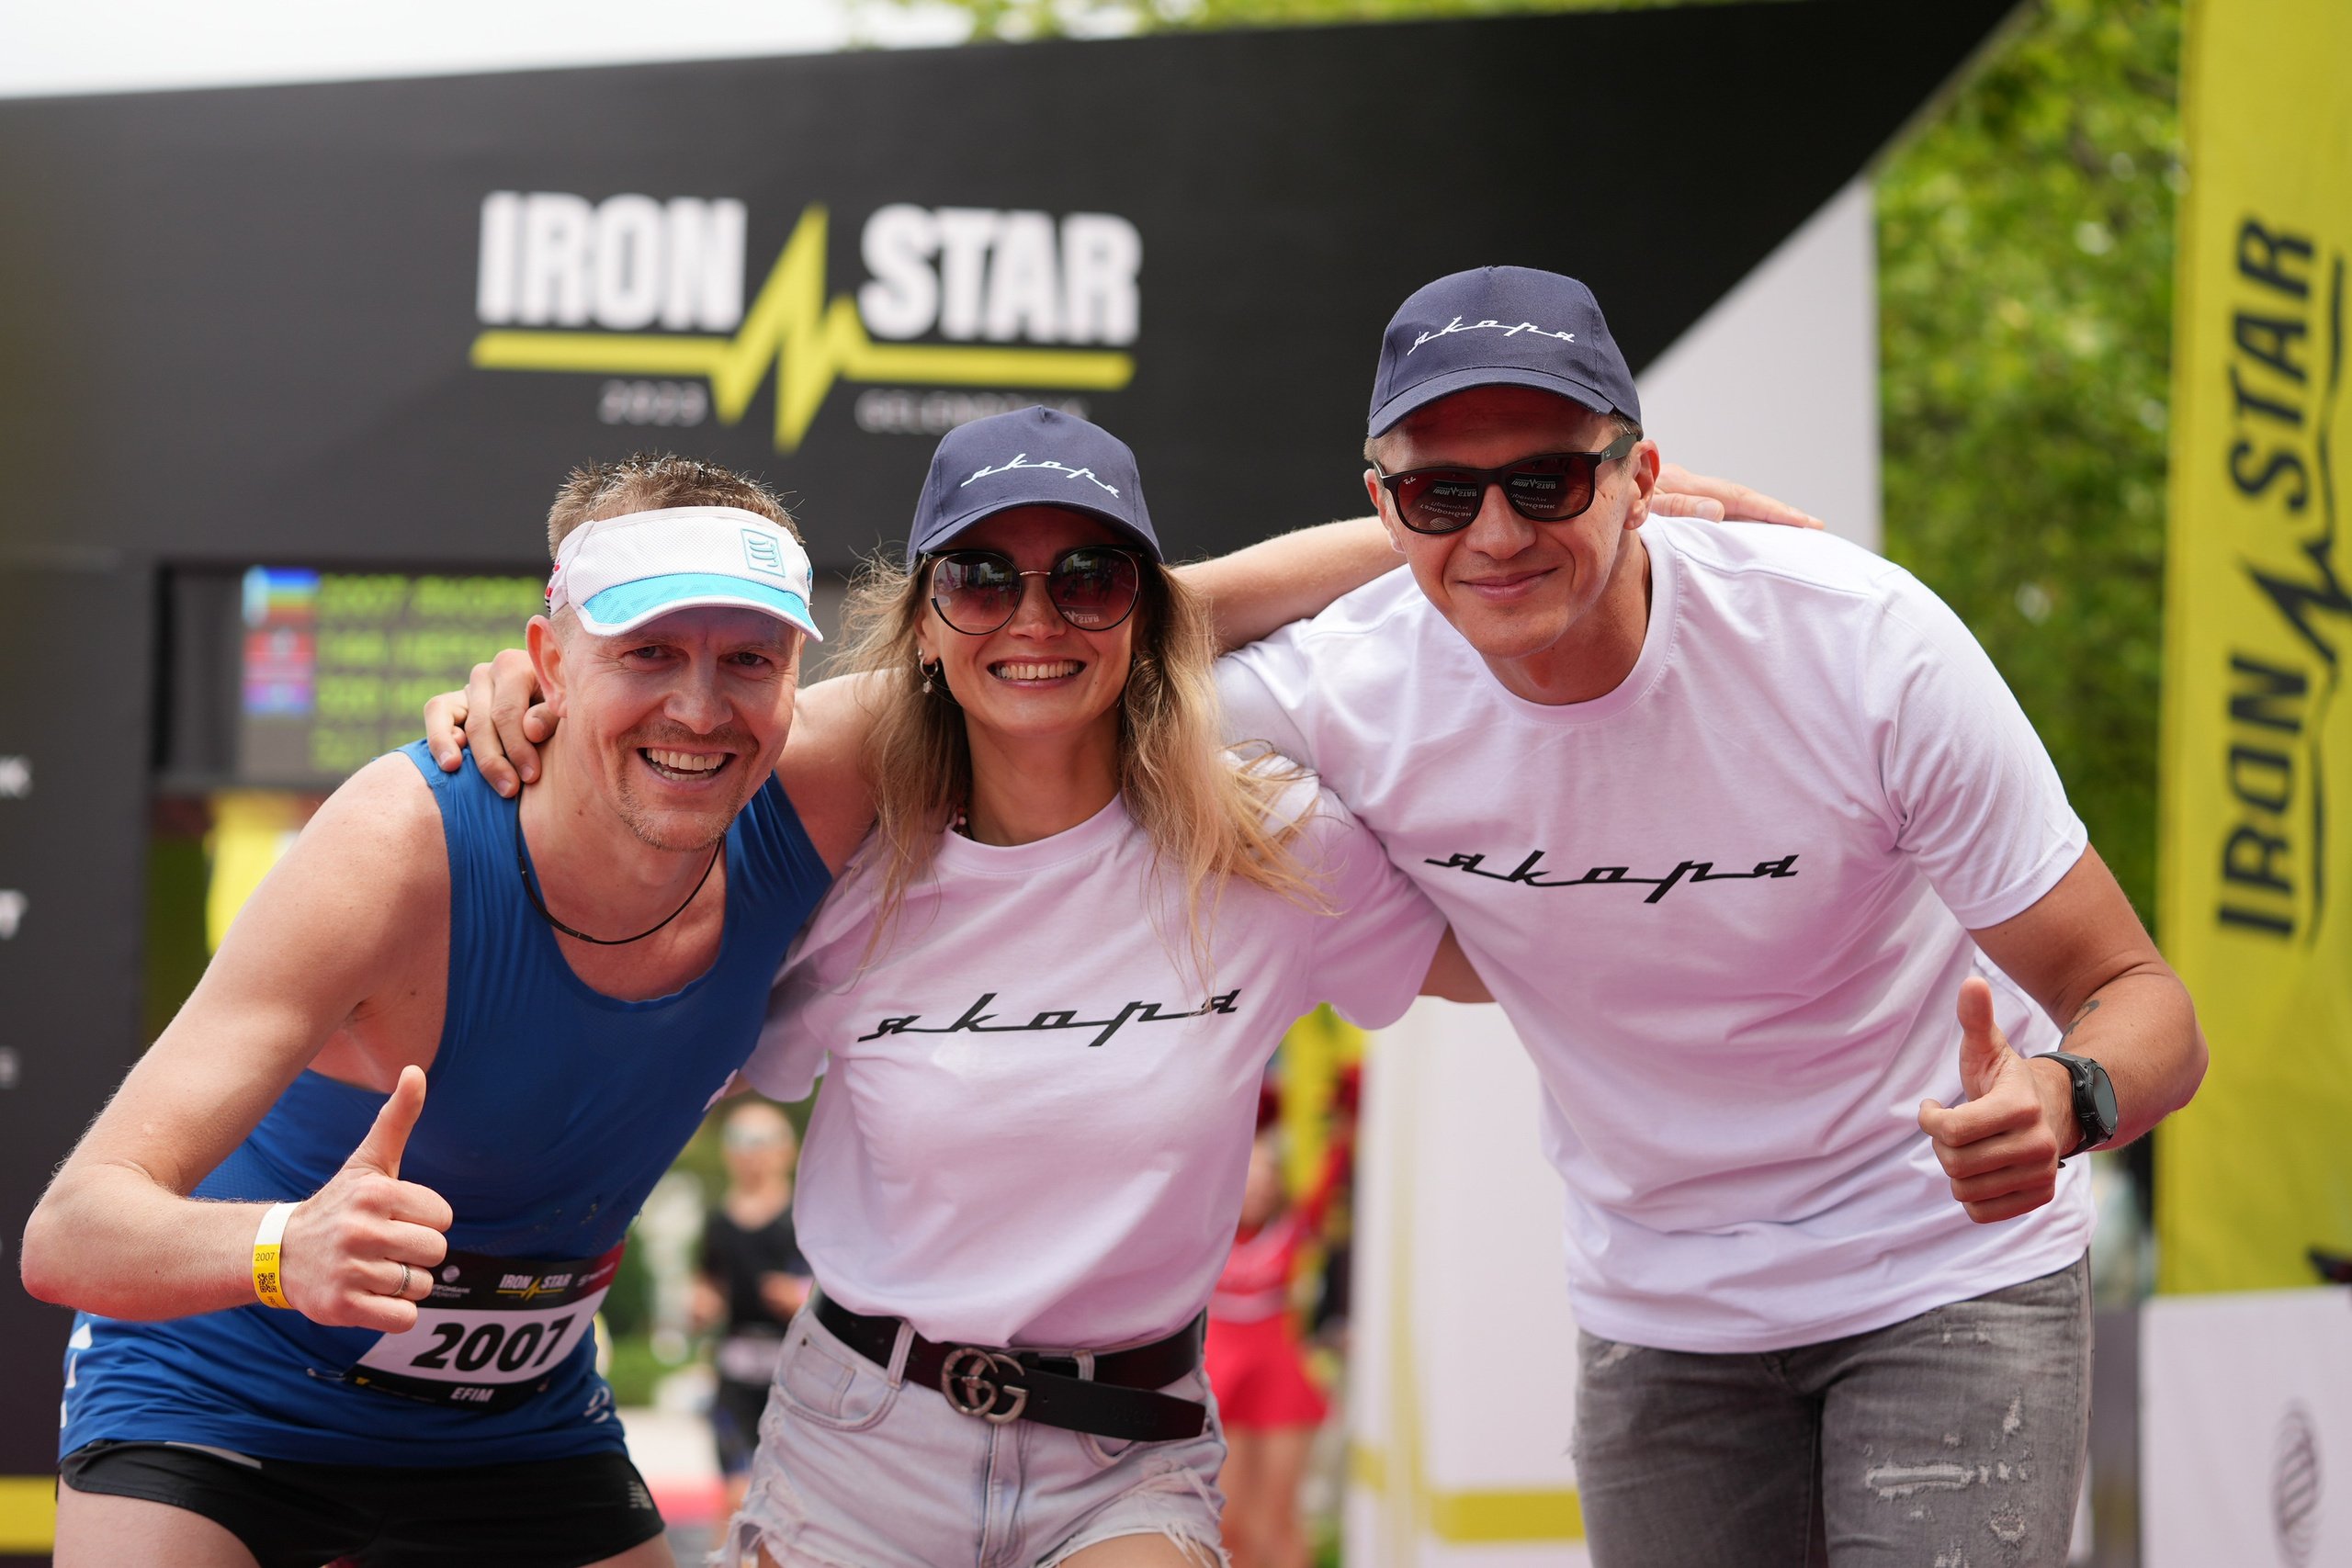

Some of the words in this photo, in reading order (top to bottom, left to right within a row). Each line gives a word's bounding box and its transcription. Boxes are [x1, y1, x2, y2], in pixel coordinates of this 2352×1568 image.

[477, 191, 747, 331] IRON
[858, 203, 1143, 346] STAR
[2228, 219, 2314, 513] STAR
[2215, 650, 2308, 941] IRON
[255, 1252, 276, 1262] 2007
[499, 1274, 533, 1289] IRON
[541, 1273, 572, 1290] STAR
[410, 1314, 577, 1372] 2007
[450, 1387, 495, 1403] EFIM
